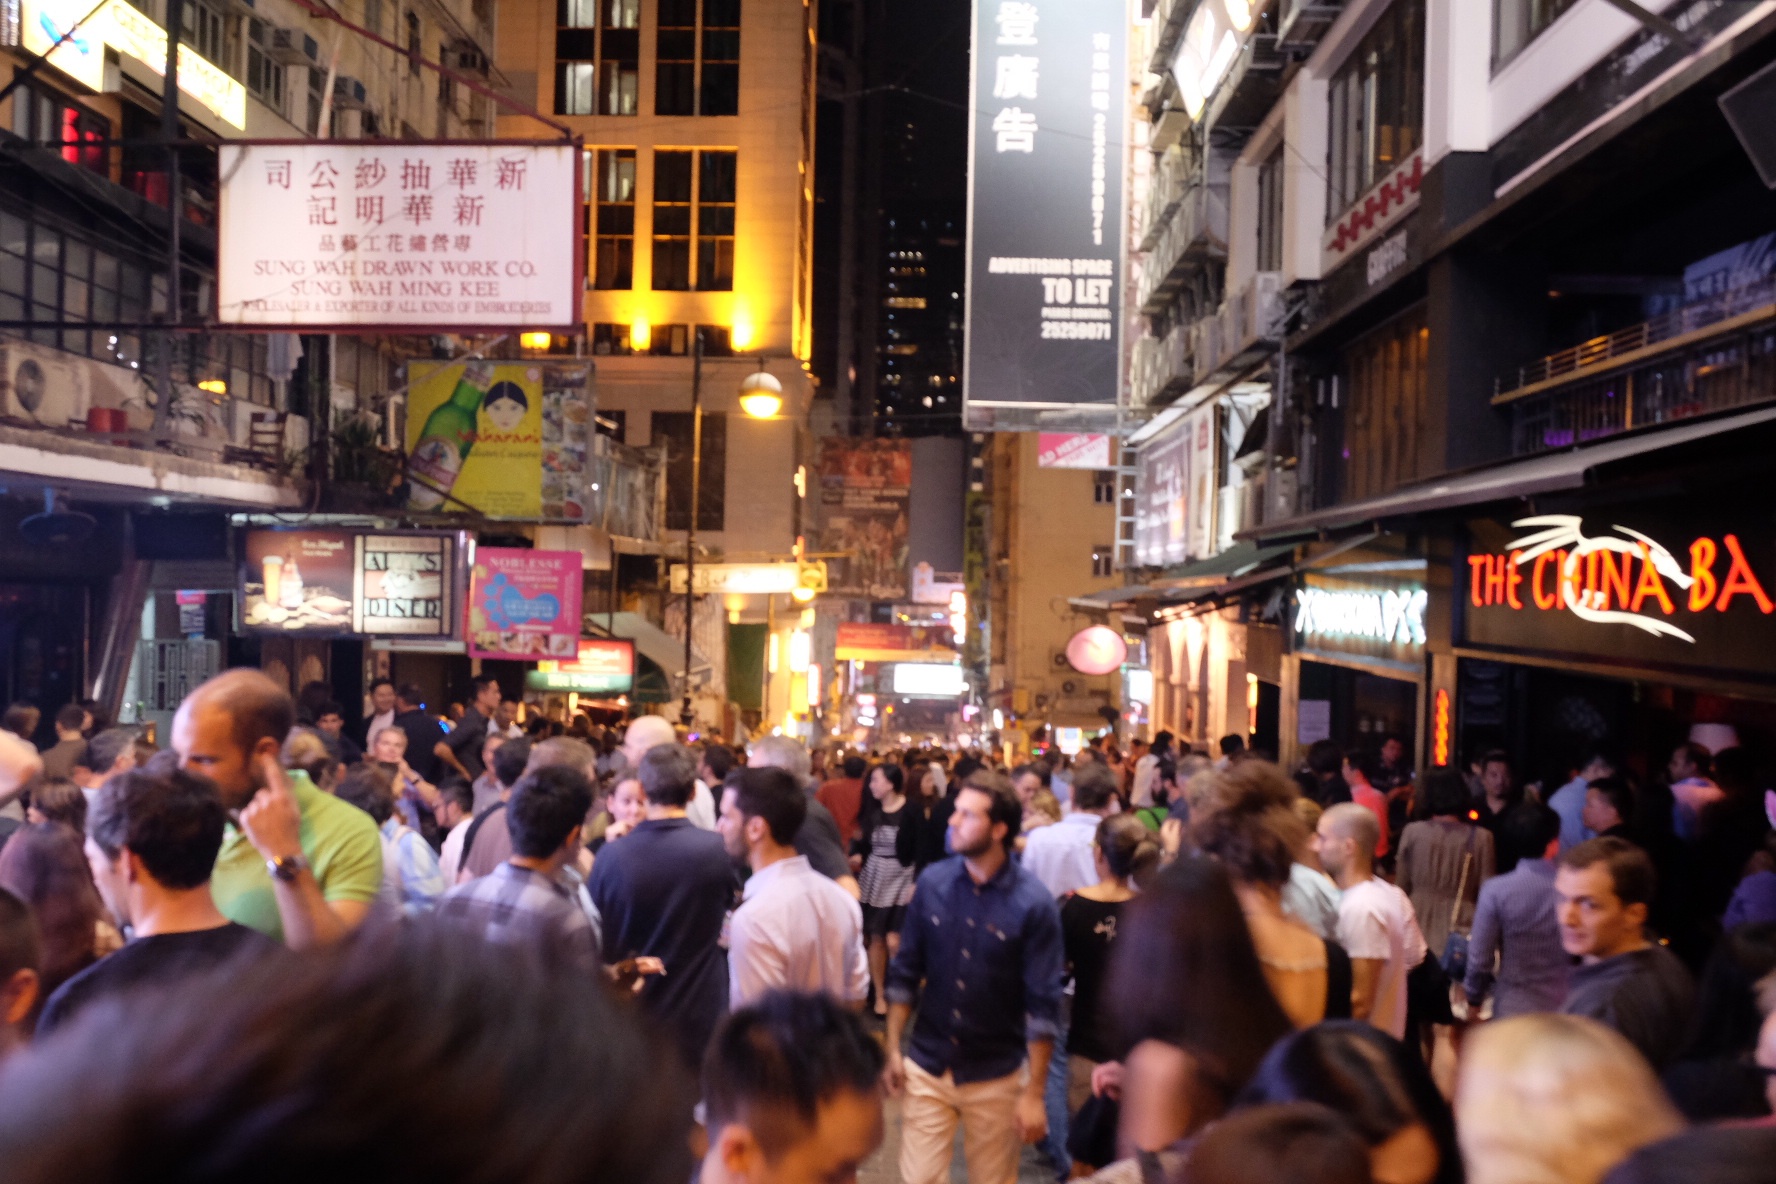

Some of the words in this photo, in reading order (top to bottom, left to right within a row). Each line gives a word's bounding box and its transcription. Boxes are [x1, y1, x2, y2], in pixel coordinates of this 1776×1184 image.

[253, 259, 306, 277] SUNG
[313, 259, 355, 276] WAH
[362, 260, 433, 276] DRAWN
[439, 260, 499, 277] WORK
[505, 260, 537, 277] CO.
[988, 257, 1072, 274] ADVERTISING
[1072, 258, 1113, 276] SPACE
[290, 280, 342, 297] SUNG
[350, 281, 393, 297] WAH
[400, 281, 452, 297] MING
[459, 281, 501, 297] KEE
[1041, 278, 1073, 304] TO
[1075, 278, 1113, 305] LET
[396, 301, 418, 314] ALL
[421, 301, 455, 315] KINDS
[457, 301, 471, 315] OF
[490, 557, 562, 570] NOBLESSE
[1467, 549, 1525, 610] THE
[1532, 540, 1676, 615] CHINA
[1687, 533, 1776, 614] BA
[367, 598, 440, 618] DINER
